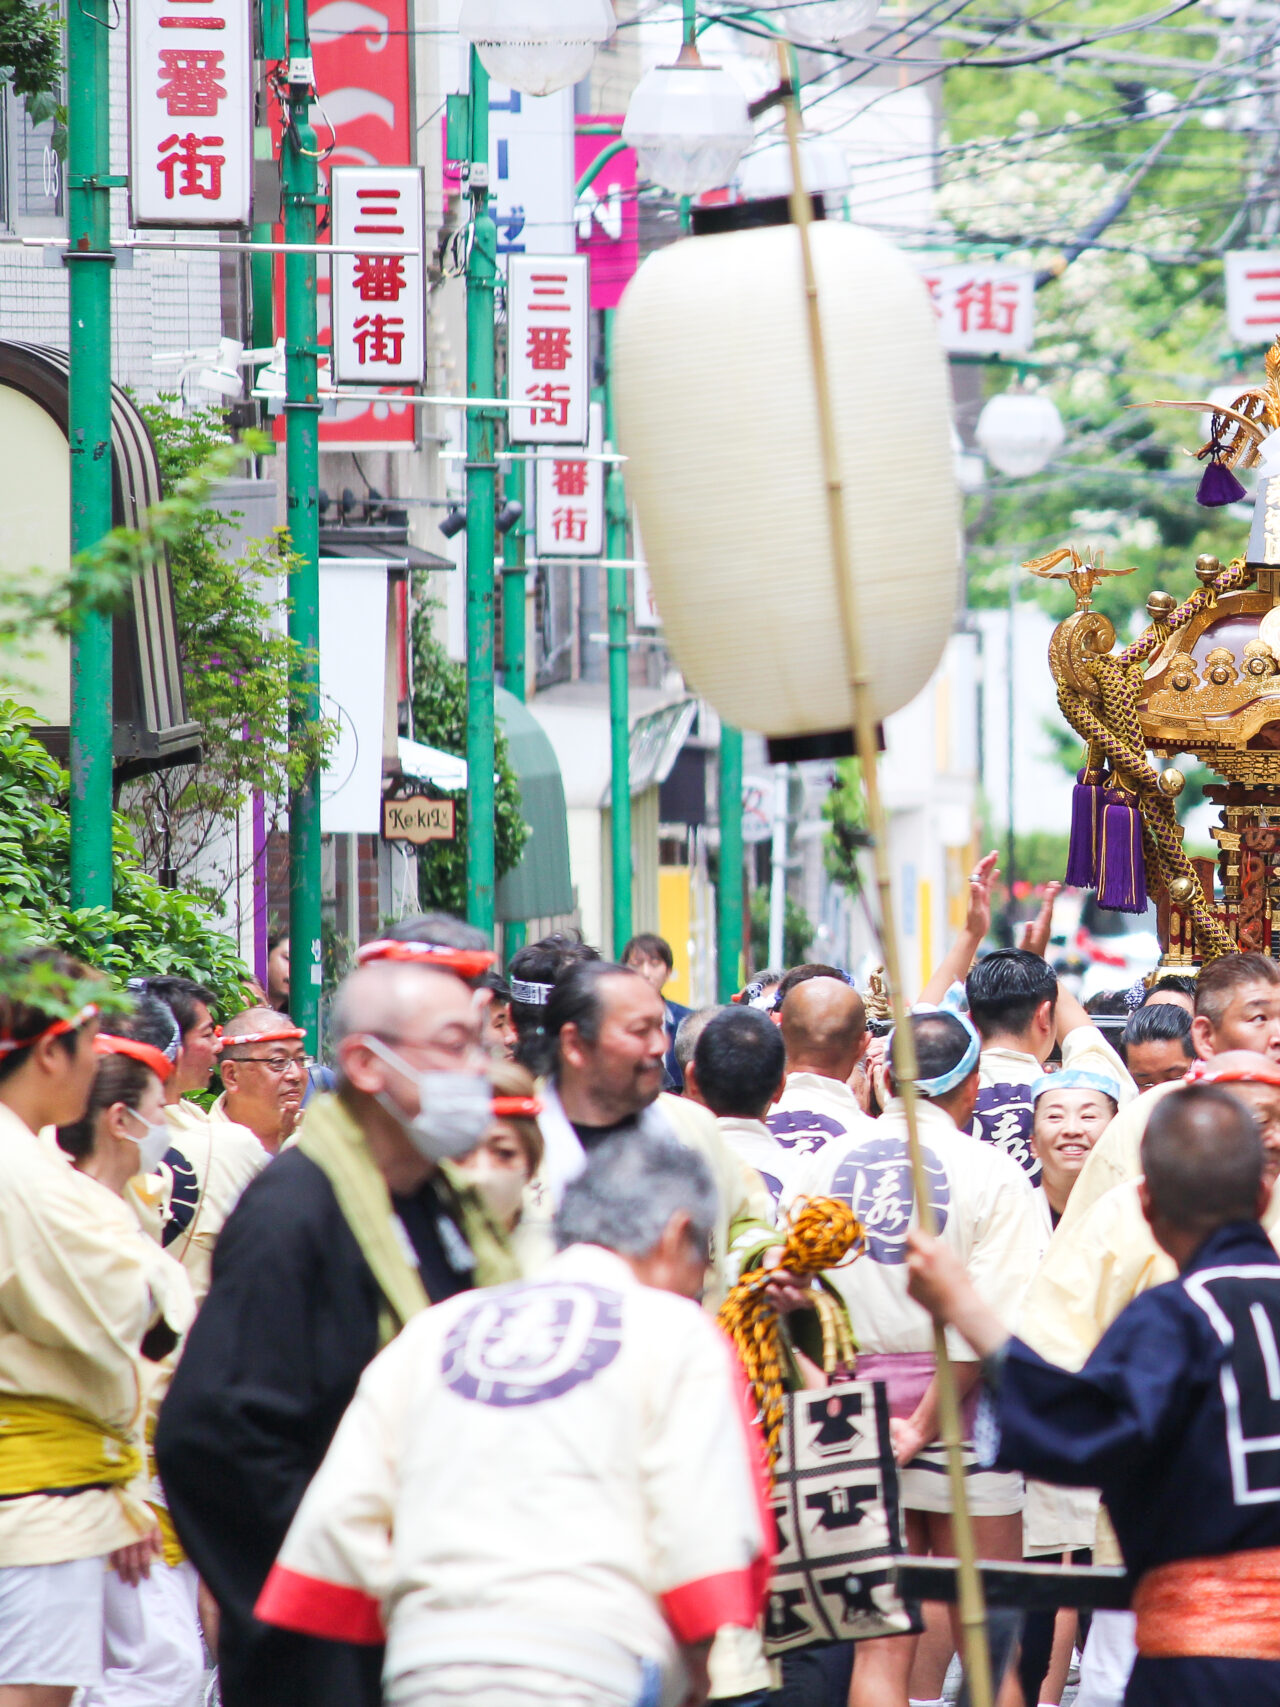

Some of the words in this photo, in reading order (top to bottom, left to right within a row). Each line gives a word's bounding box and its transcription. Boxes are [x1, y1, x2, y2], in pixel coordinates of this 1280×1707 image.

[43, 145, 59, 198] 03
[353, 189, 407, 364] 三番街
[525, 274, 573, 426] 三番街
